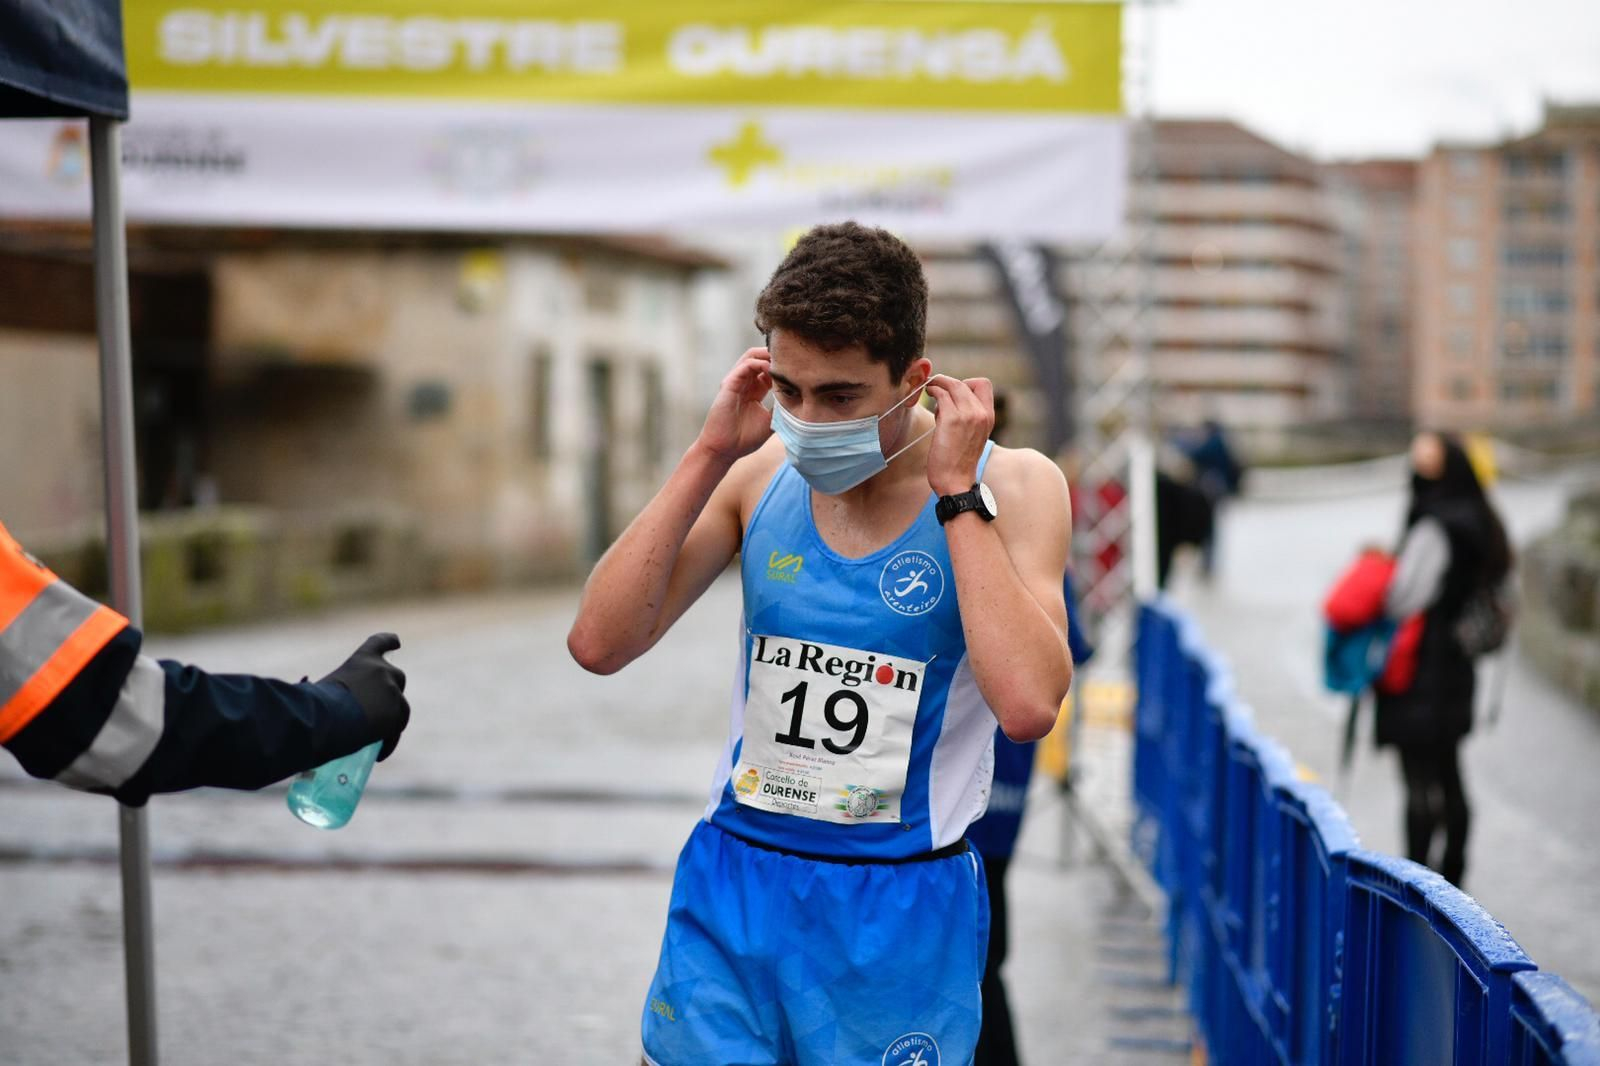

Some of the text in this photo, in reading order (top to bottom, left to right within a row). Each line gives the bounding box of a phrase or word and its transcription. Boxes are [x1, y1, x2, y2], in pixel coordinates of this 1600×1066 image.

[159, 8, 624, 75] SILVESTRE
[892, 555, 936, 575] atletismo
[884, 590, 937, 613] arenteiro
[755, 636, 918, 692] La Región
[775, 680, 869, 755] 19
[763, 783, 817, 803] OURENSE
[798, 778, 808, 788] de
[892, 1036, 932, 1056] atletismo
